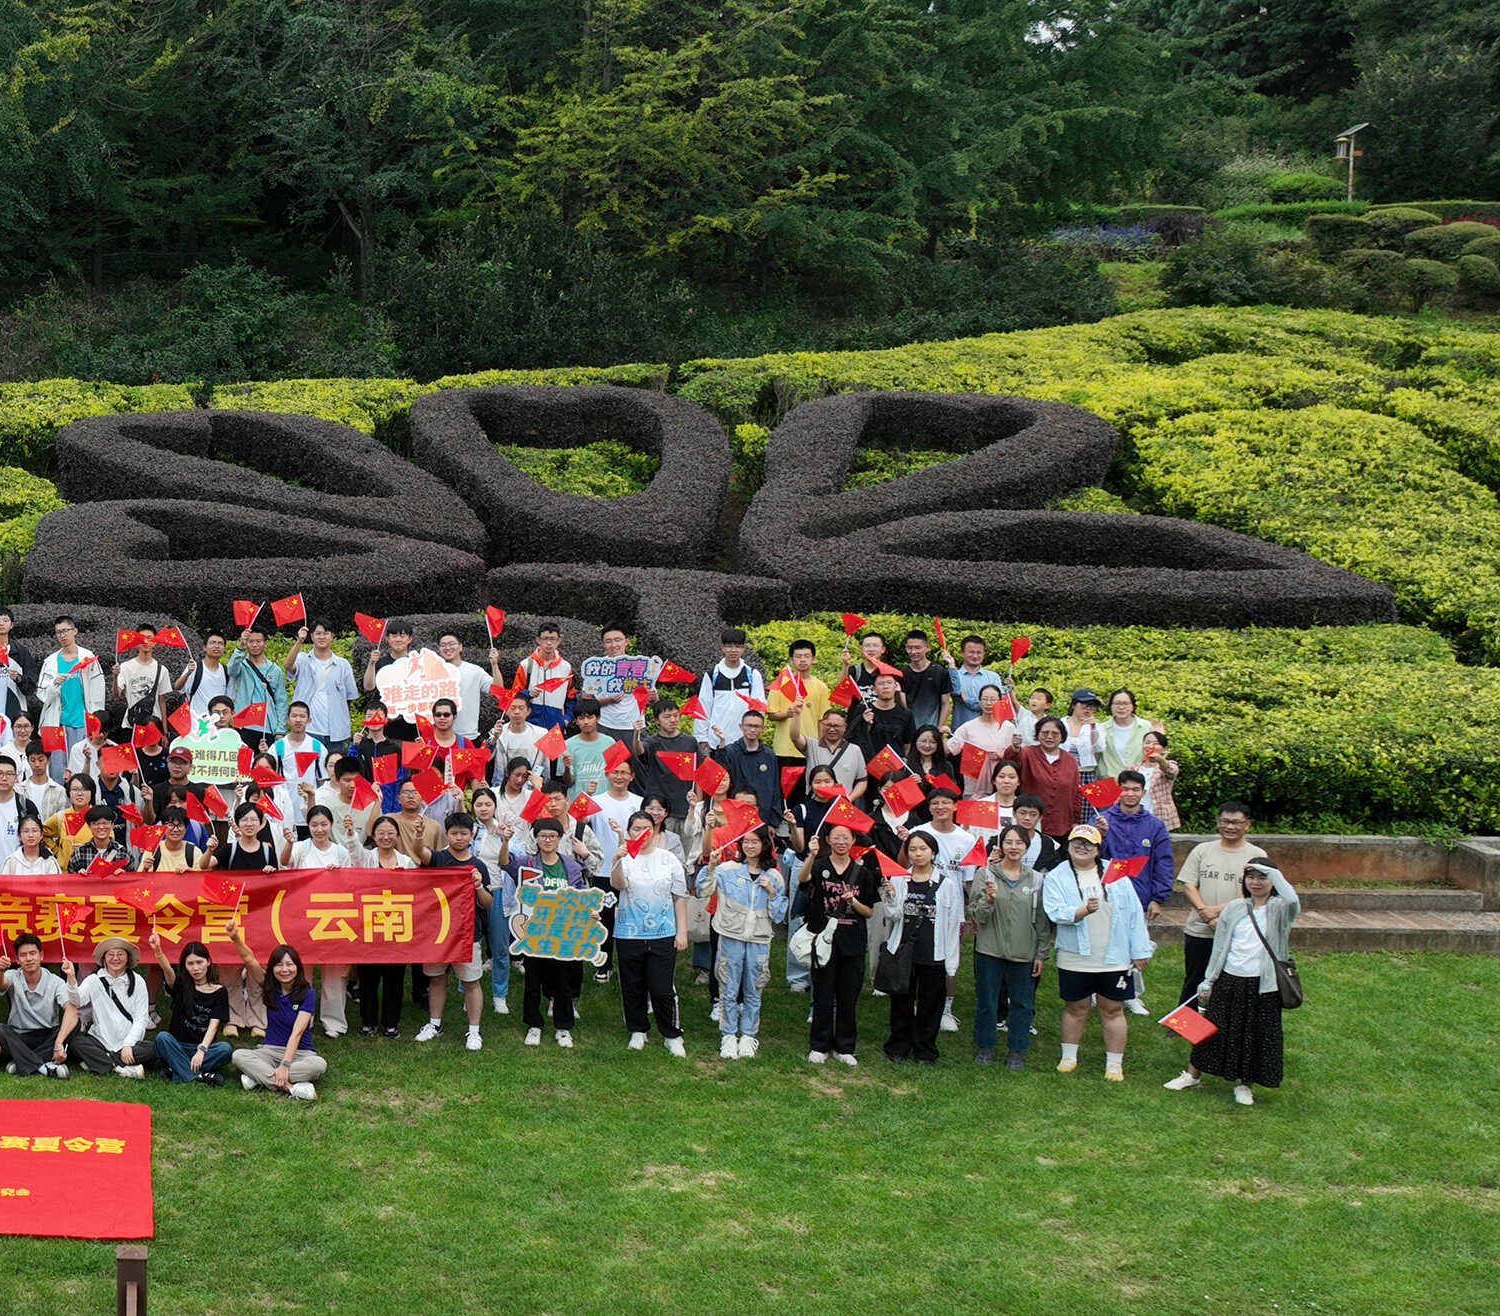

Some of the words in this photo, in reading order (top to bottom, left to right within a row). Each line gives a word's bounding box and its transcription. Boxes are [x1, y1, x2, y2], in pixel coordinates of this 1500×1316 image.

[382, 681, 458, 703] 难走的路
[1200, 870, 1220, 879] FEAR
[1224, 873, 1236, 881] OF
